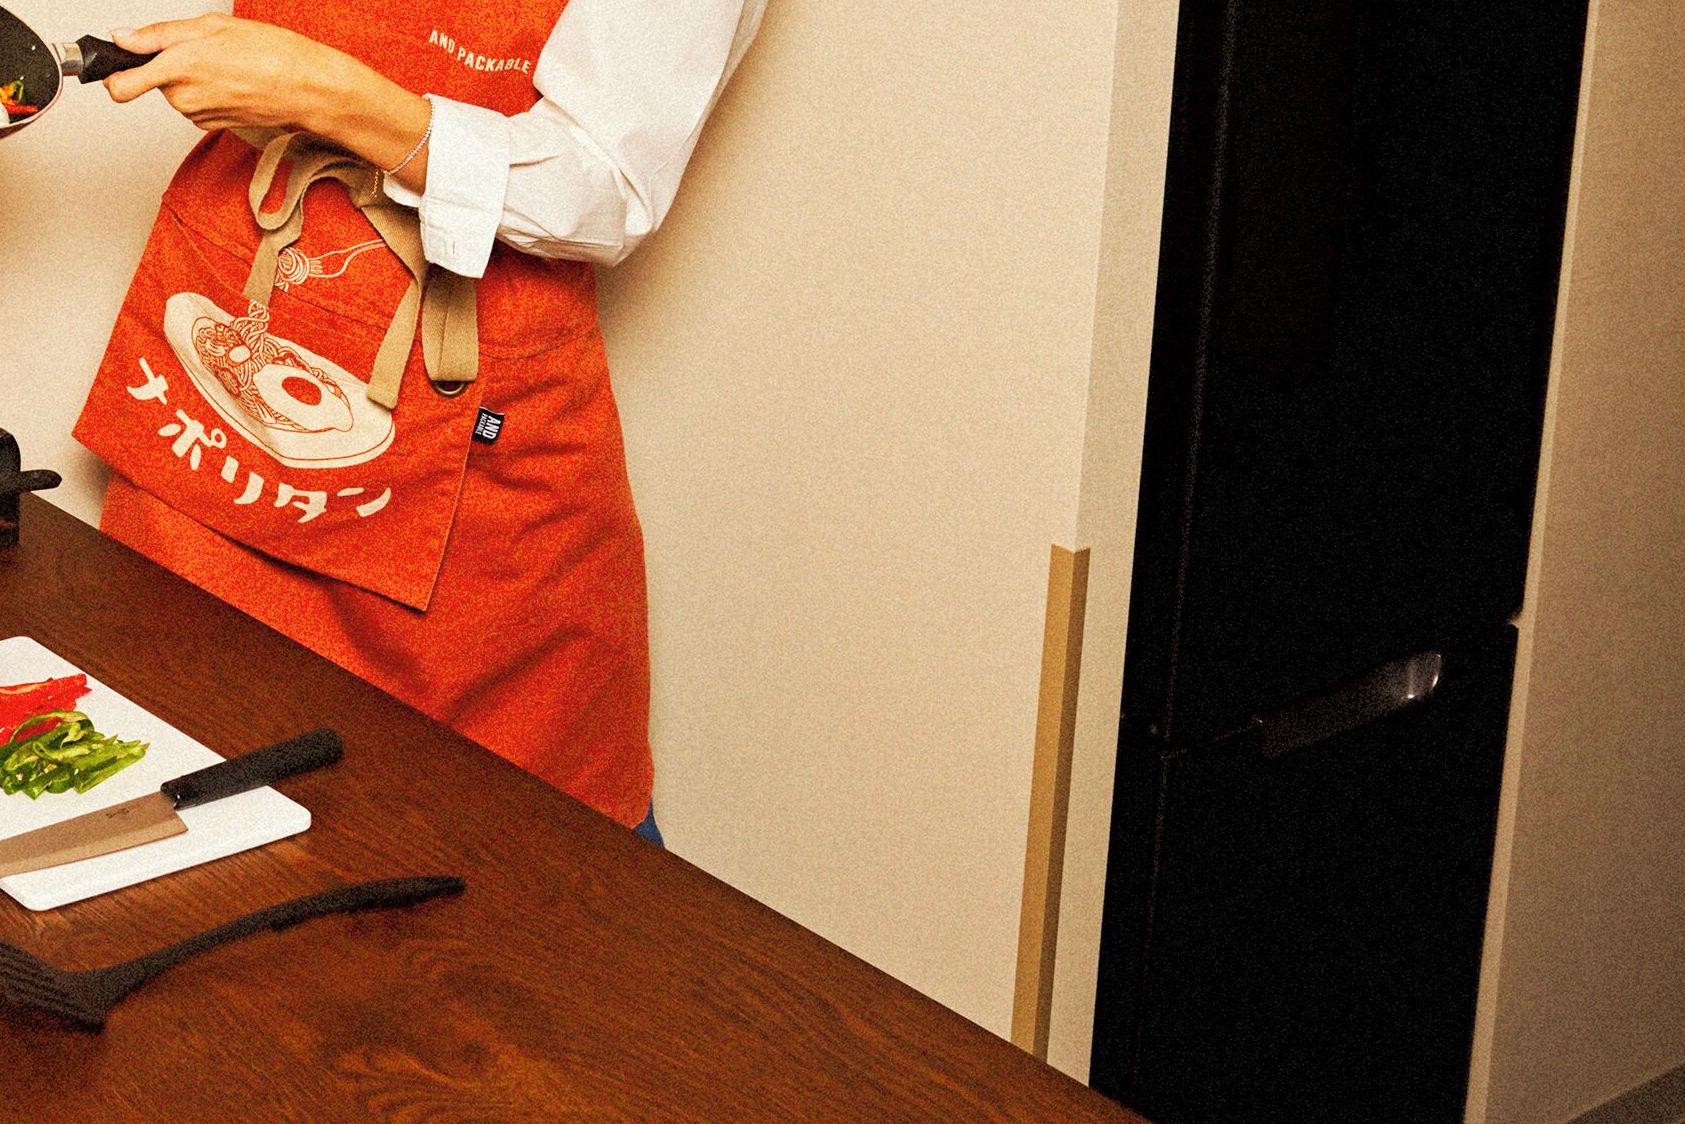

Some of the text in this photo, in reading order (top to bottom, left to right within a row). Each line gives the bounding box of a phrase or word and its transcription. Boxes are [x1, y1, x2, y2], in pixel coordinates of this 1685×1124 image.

[429, 29, 531, 74] AND PACKABLE
[126, 357, 392, 524] ナポリタン
[482, 416, 501, 439] AND
